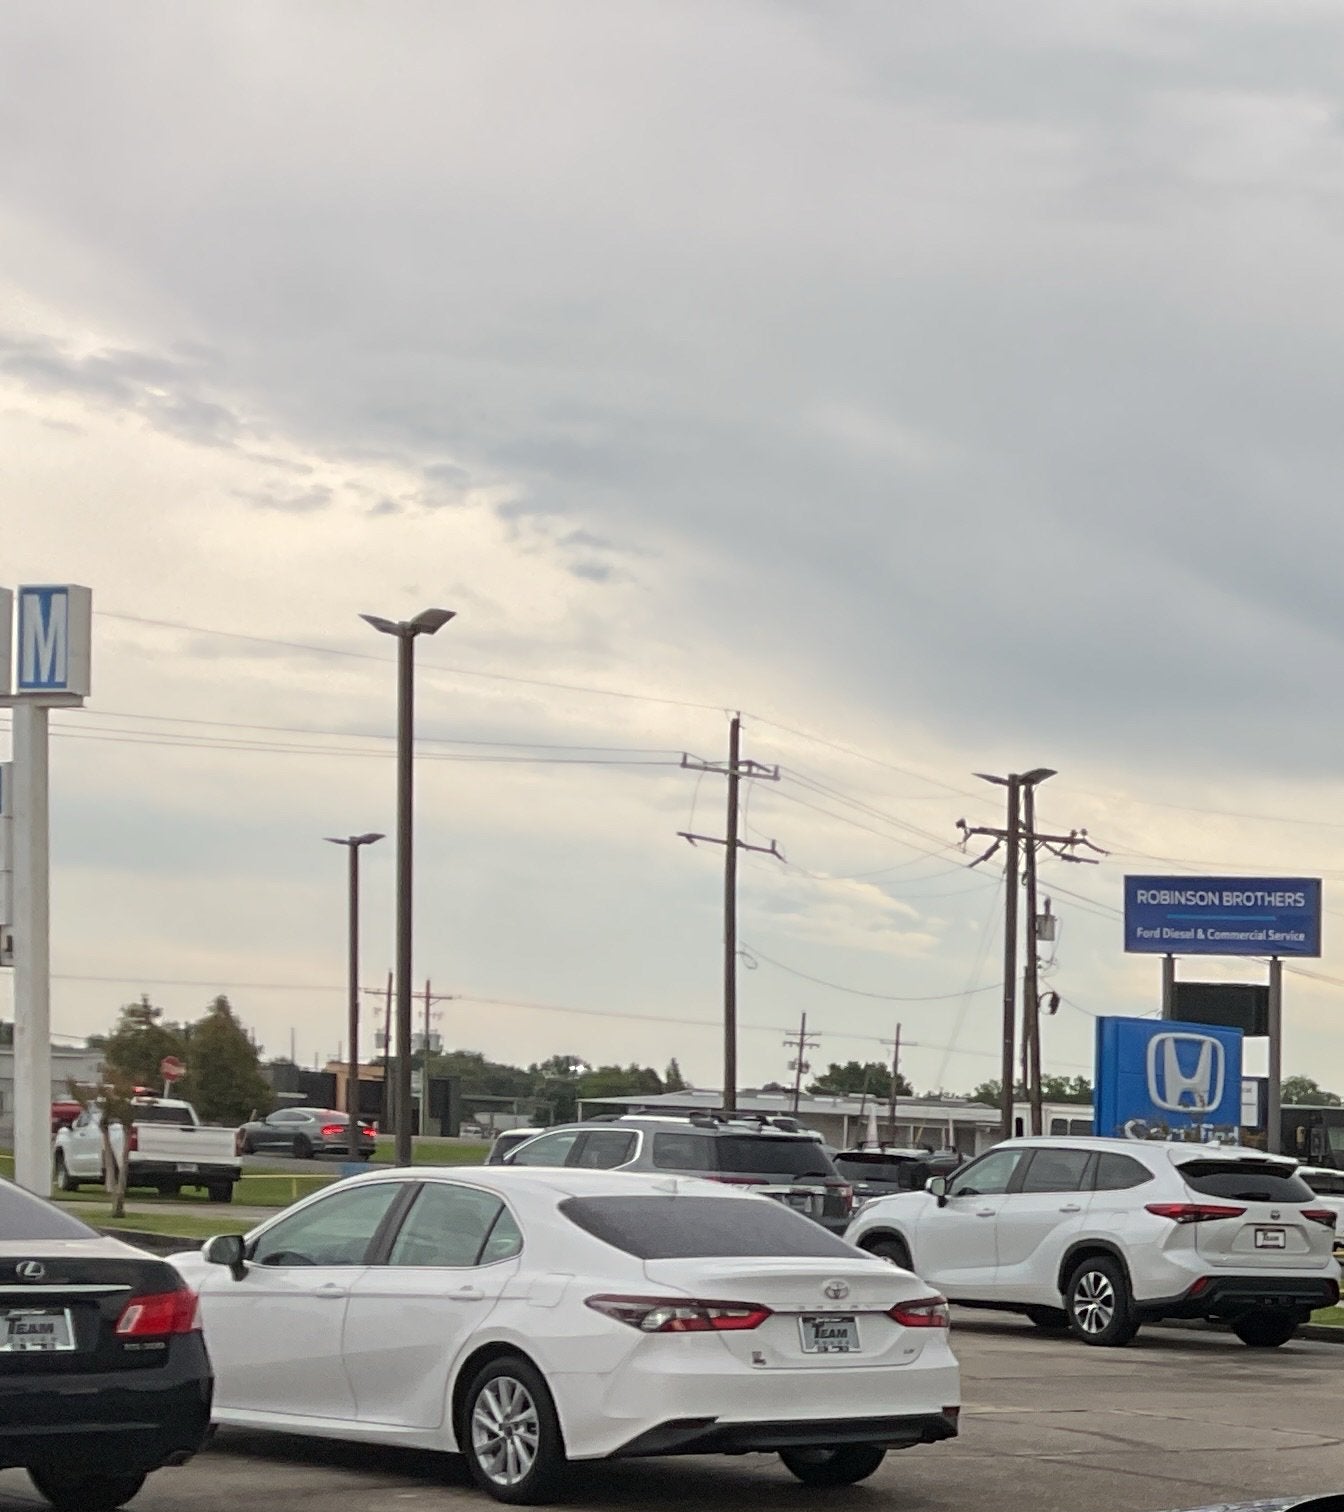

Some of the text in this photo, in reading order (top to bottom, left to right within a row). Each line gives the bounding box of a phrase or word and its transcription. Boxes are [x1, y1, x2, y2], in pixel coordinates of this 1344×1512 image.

[22, 593, 67, 683] M
[1136, 889, 1305, 908] ROBINSON BROTHERS
[1136, 926, 1305, 942] Ford Diesel & Commercial Service
